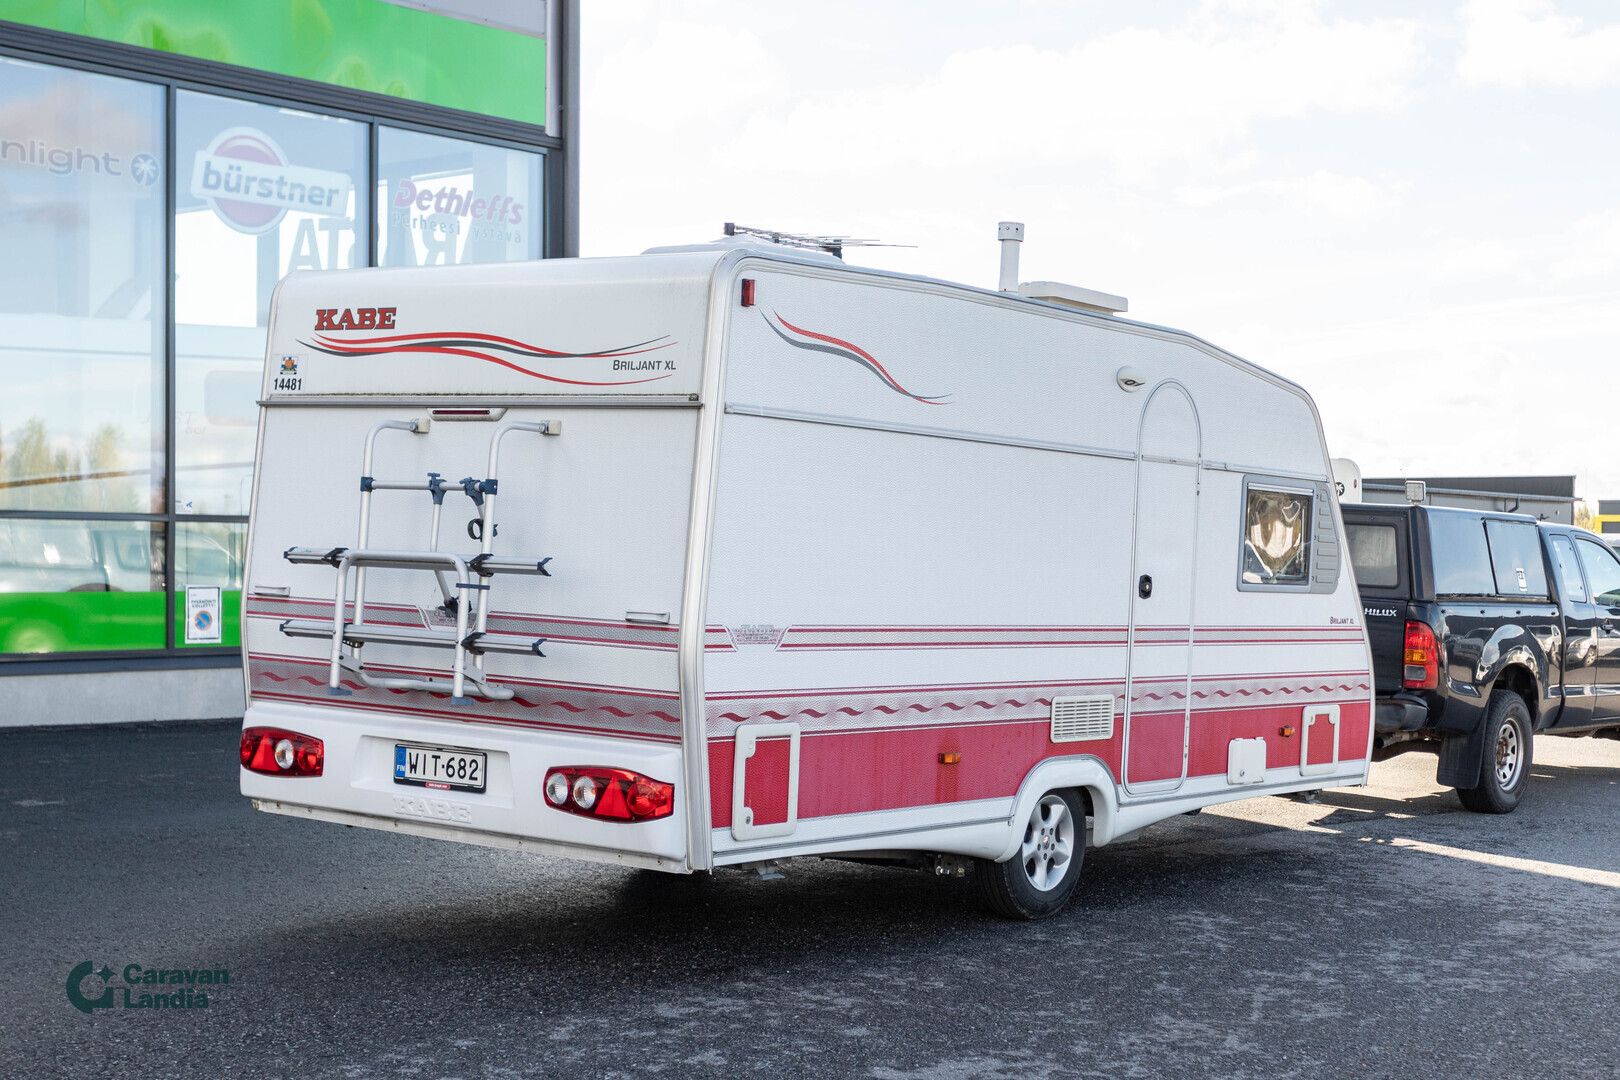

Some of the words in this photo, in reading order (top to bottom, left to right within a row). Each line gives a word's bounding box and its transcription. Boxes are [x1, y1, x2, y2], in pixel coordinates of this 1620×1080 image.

[202, 161, 340, 207] bürstner
[395, 180, 525, 225] Dethleffs
[315, 307, 397, 331] KABE
[664, 360, 677, 370] XL
[274, 378, 302, 391] 14481
[1363, 607, 1397, 617] HILUX
[408, 752, 479, 781] WIT-682
